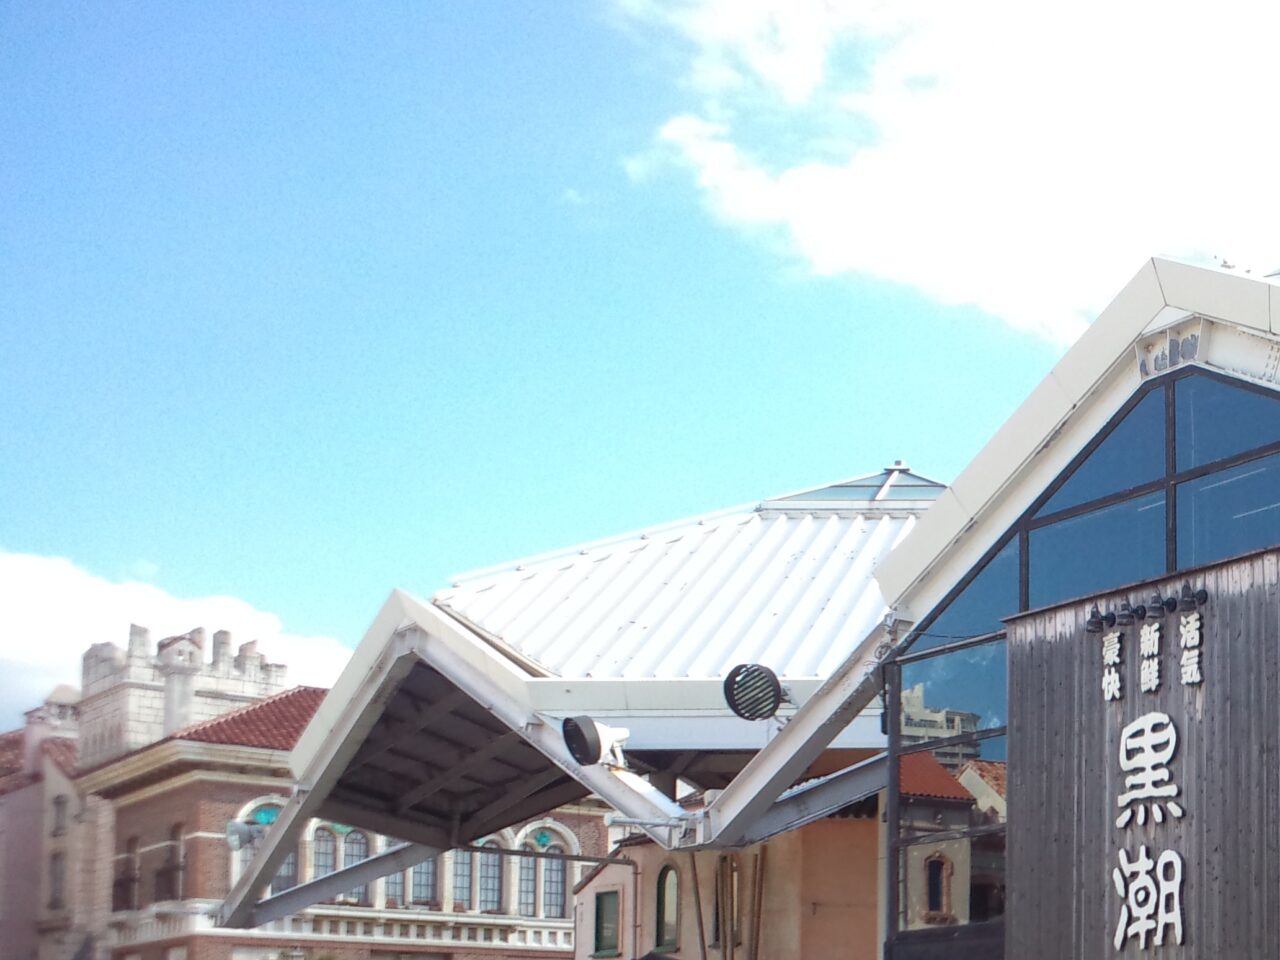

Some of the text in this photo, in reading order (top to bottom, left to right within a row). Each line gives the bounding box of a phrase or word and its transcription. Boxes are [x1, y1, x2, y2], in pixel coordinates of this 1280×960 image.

[1102, 631, 1121, 701] 豪快
[1140, 622, 1160, 693] 新鮮
[1180, 612, 1202, 685] 活気
